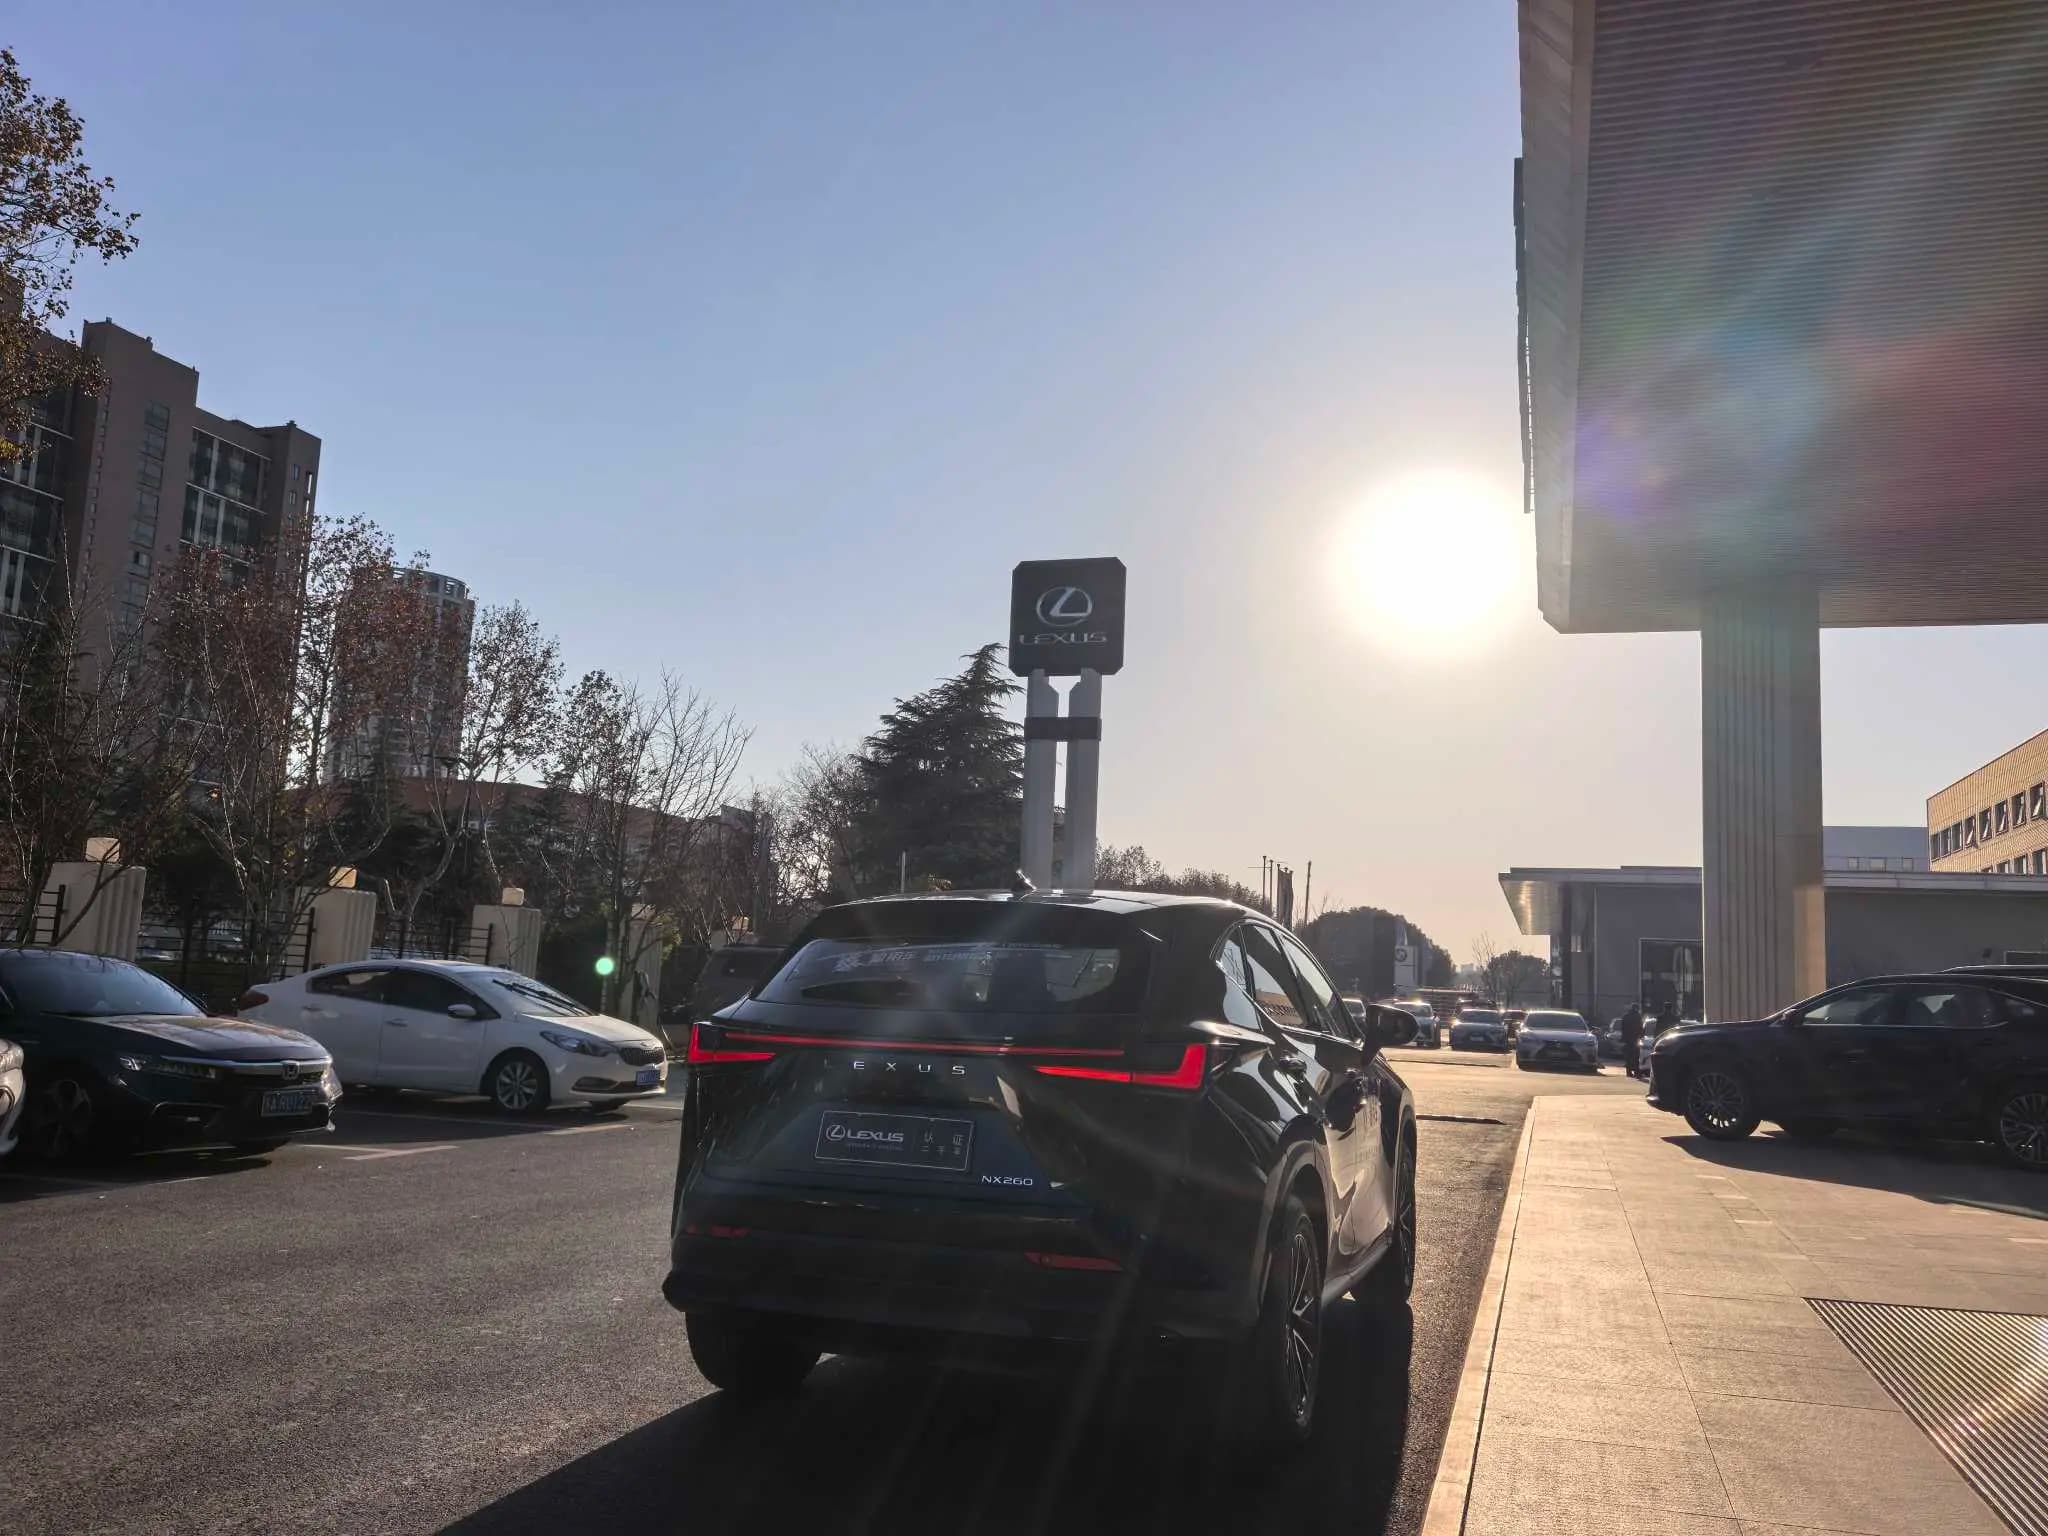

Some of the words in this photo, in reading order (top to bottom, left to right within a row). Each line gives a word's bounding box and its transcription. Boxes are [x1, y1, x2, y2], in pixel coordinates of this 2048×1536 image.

[1018, 632, 1109, 647] LEXUS
[823, 1058, 966, 1075] LEXUS
[847, 1129, 905, 1143] LEXUS
[981, 1175, 1033, 1186] NX260
